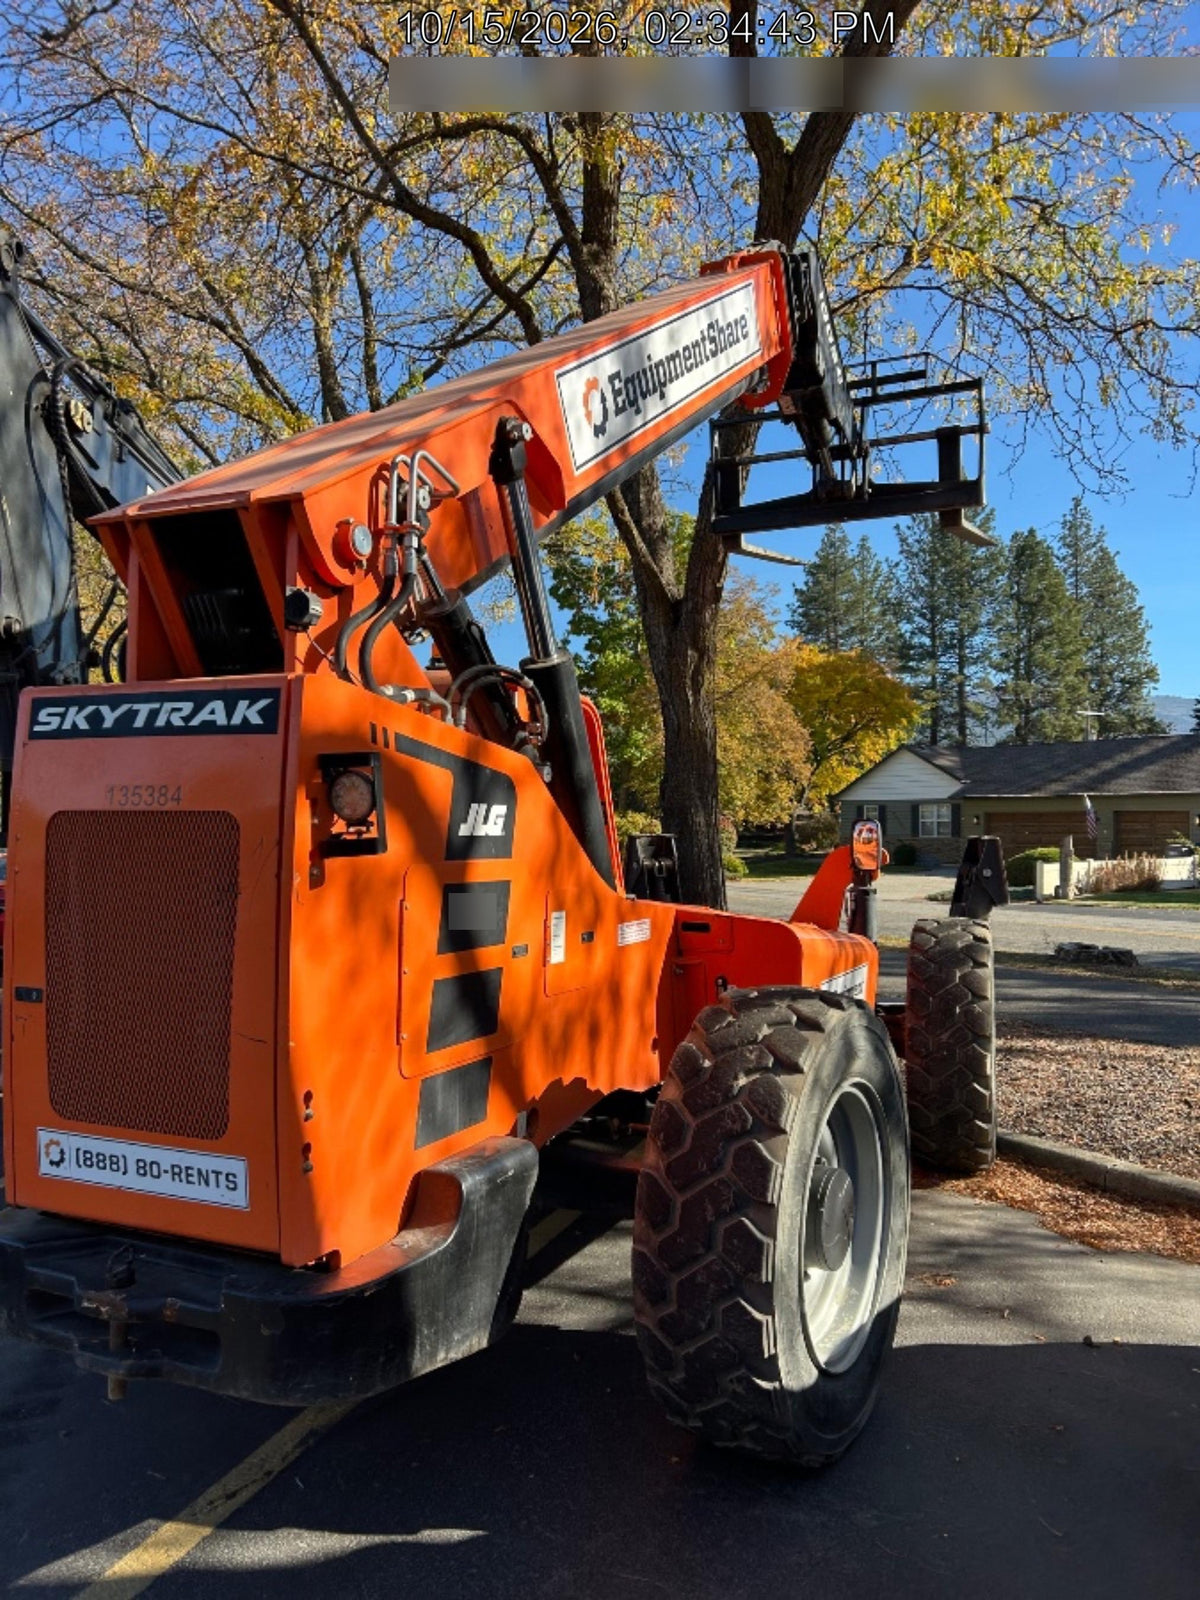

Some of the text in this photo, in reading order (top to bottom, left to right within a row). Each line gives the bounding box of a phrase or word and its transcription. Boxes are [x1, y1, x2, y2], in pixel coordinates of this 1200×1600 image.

[608, 313, 749, 416] EquipmentShare
[33, 698, 274, 732] SKYTRAK
[106, 785, 182, 807] 135384
[458, 803, 507, 836] JLG
[75, 1147, 238, 1192] (888) 80-RENTS
